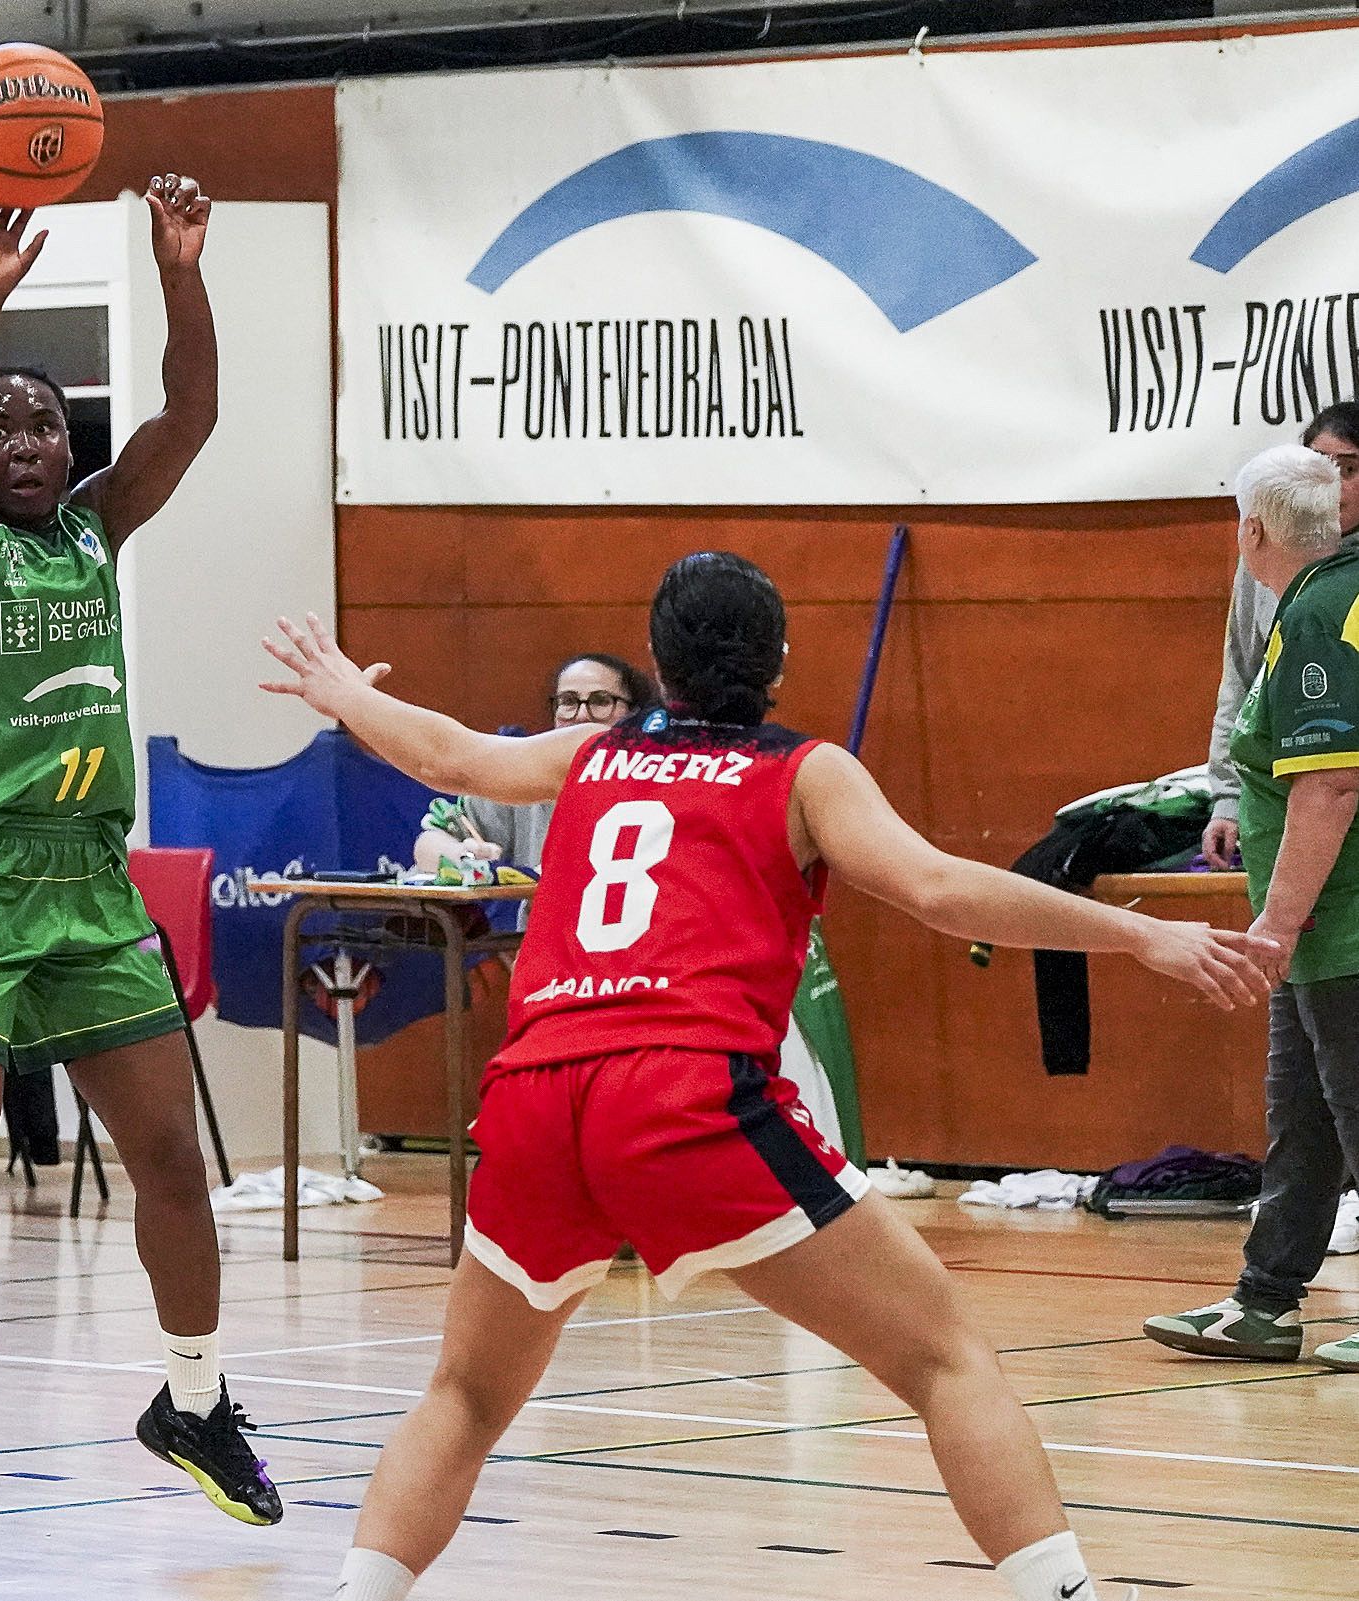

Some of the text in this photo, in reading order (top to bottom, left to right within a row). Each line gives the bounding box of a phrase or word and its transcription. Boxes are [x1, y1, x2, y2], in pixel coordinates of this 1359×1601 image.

[378, 315, 805, 440] VISIT-PONTEVEDRA.GAL
[47, 598, 106, 620] XUNTA
[49, 623, 73, 642] DE
[55, 746, 106, 802] 11
[578, 749, 754, 787] ANGERIZ
[575, 800, 676, 954] 8
